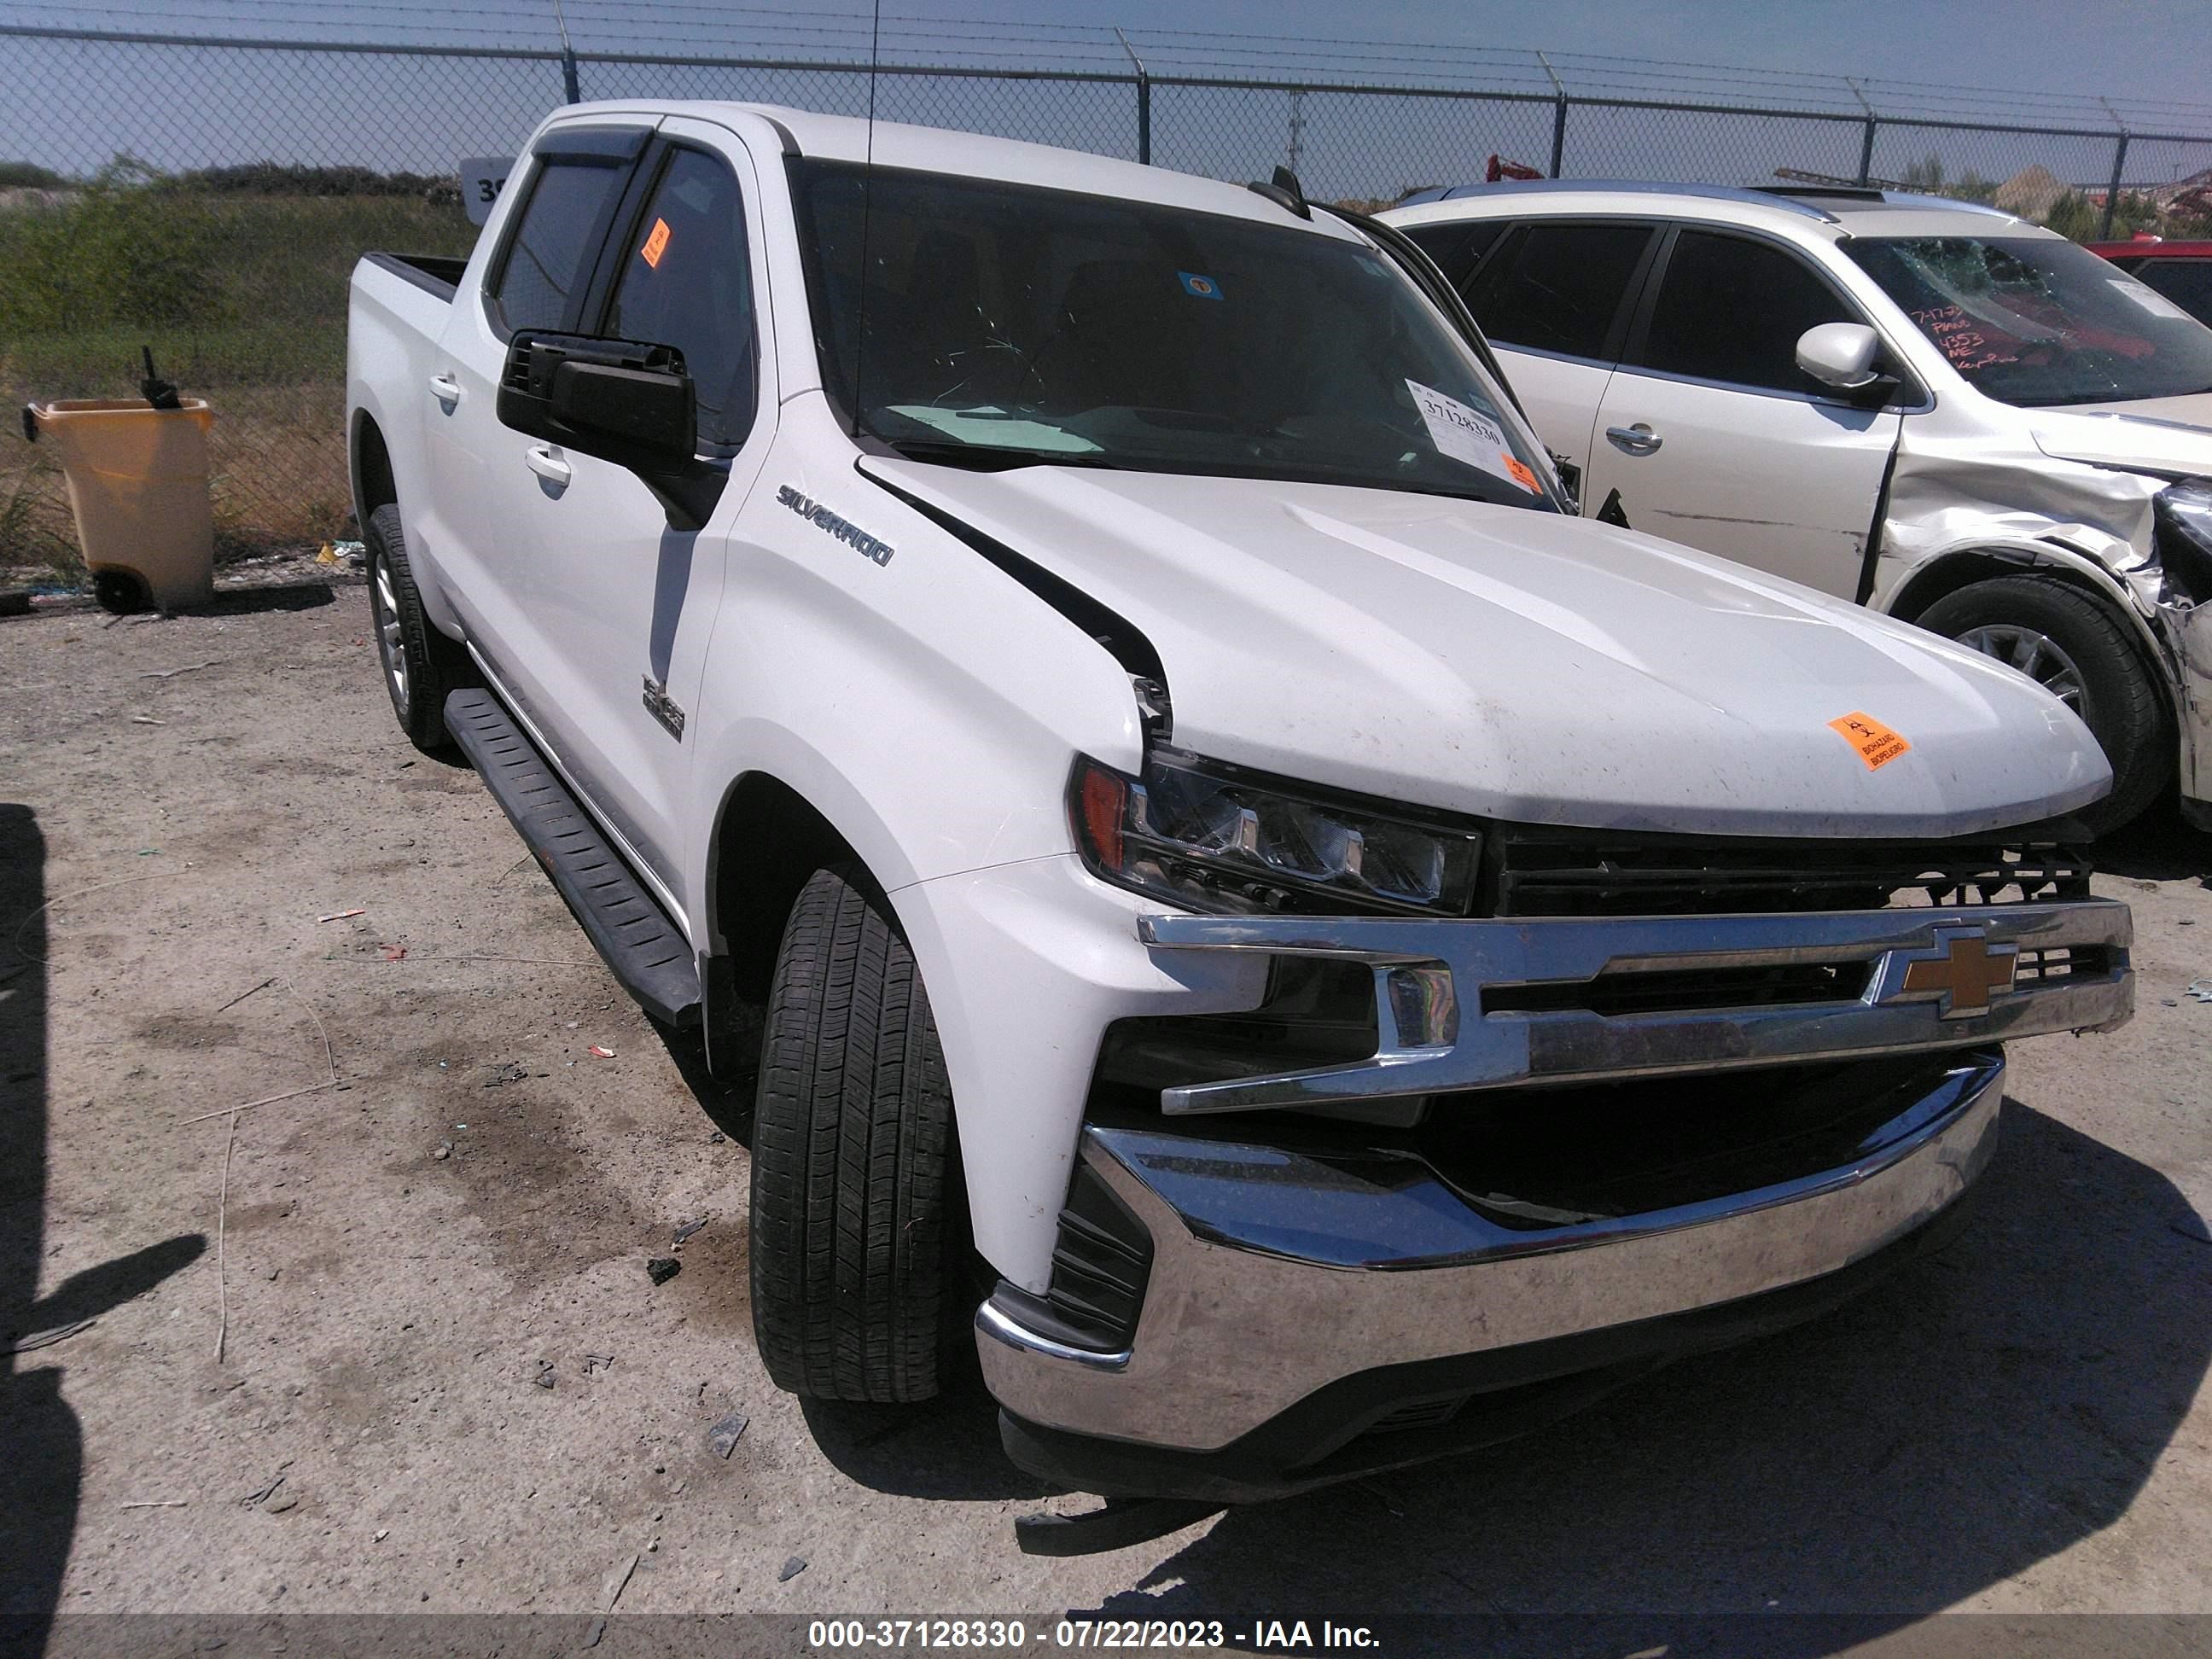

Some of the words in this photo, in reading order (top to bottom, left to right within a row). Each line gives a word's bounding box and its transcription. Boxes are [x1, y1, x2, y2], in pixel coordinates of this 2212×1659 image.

[1423, 399, 1500, 445] 37128330
[775, 484, 895, 568] SILVERADO
[1861, 733, 1895, 755] BIOHAZARD
[1870, 742, 1905, 766] BIOPELIGRO
